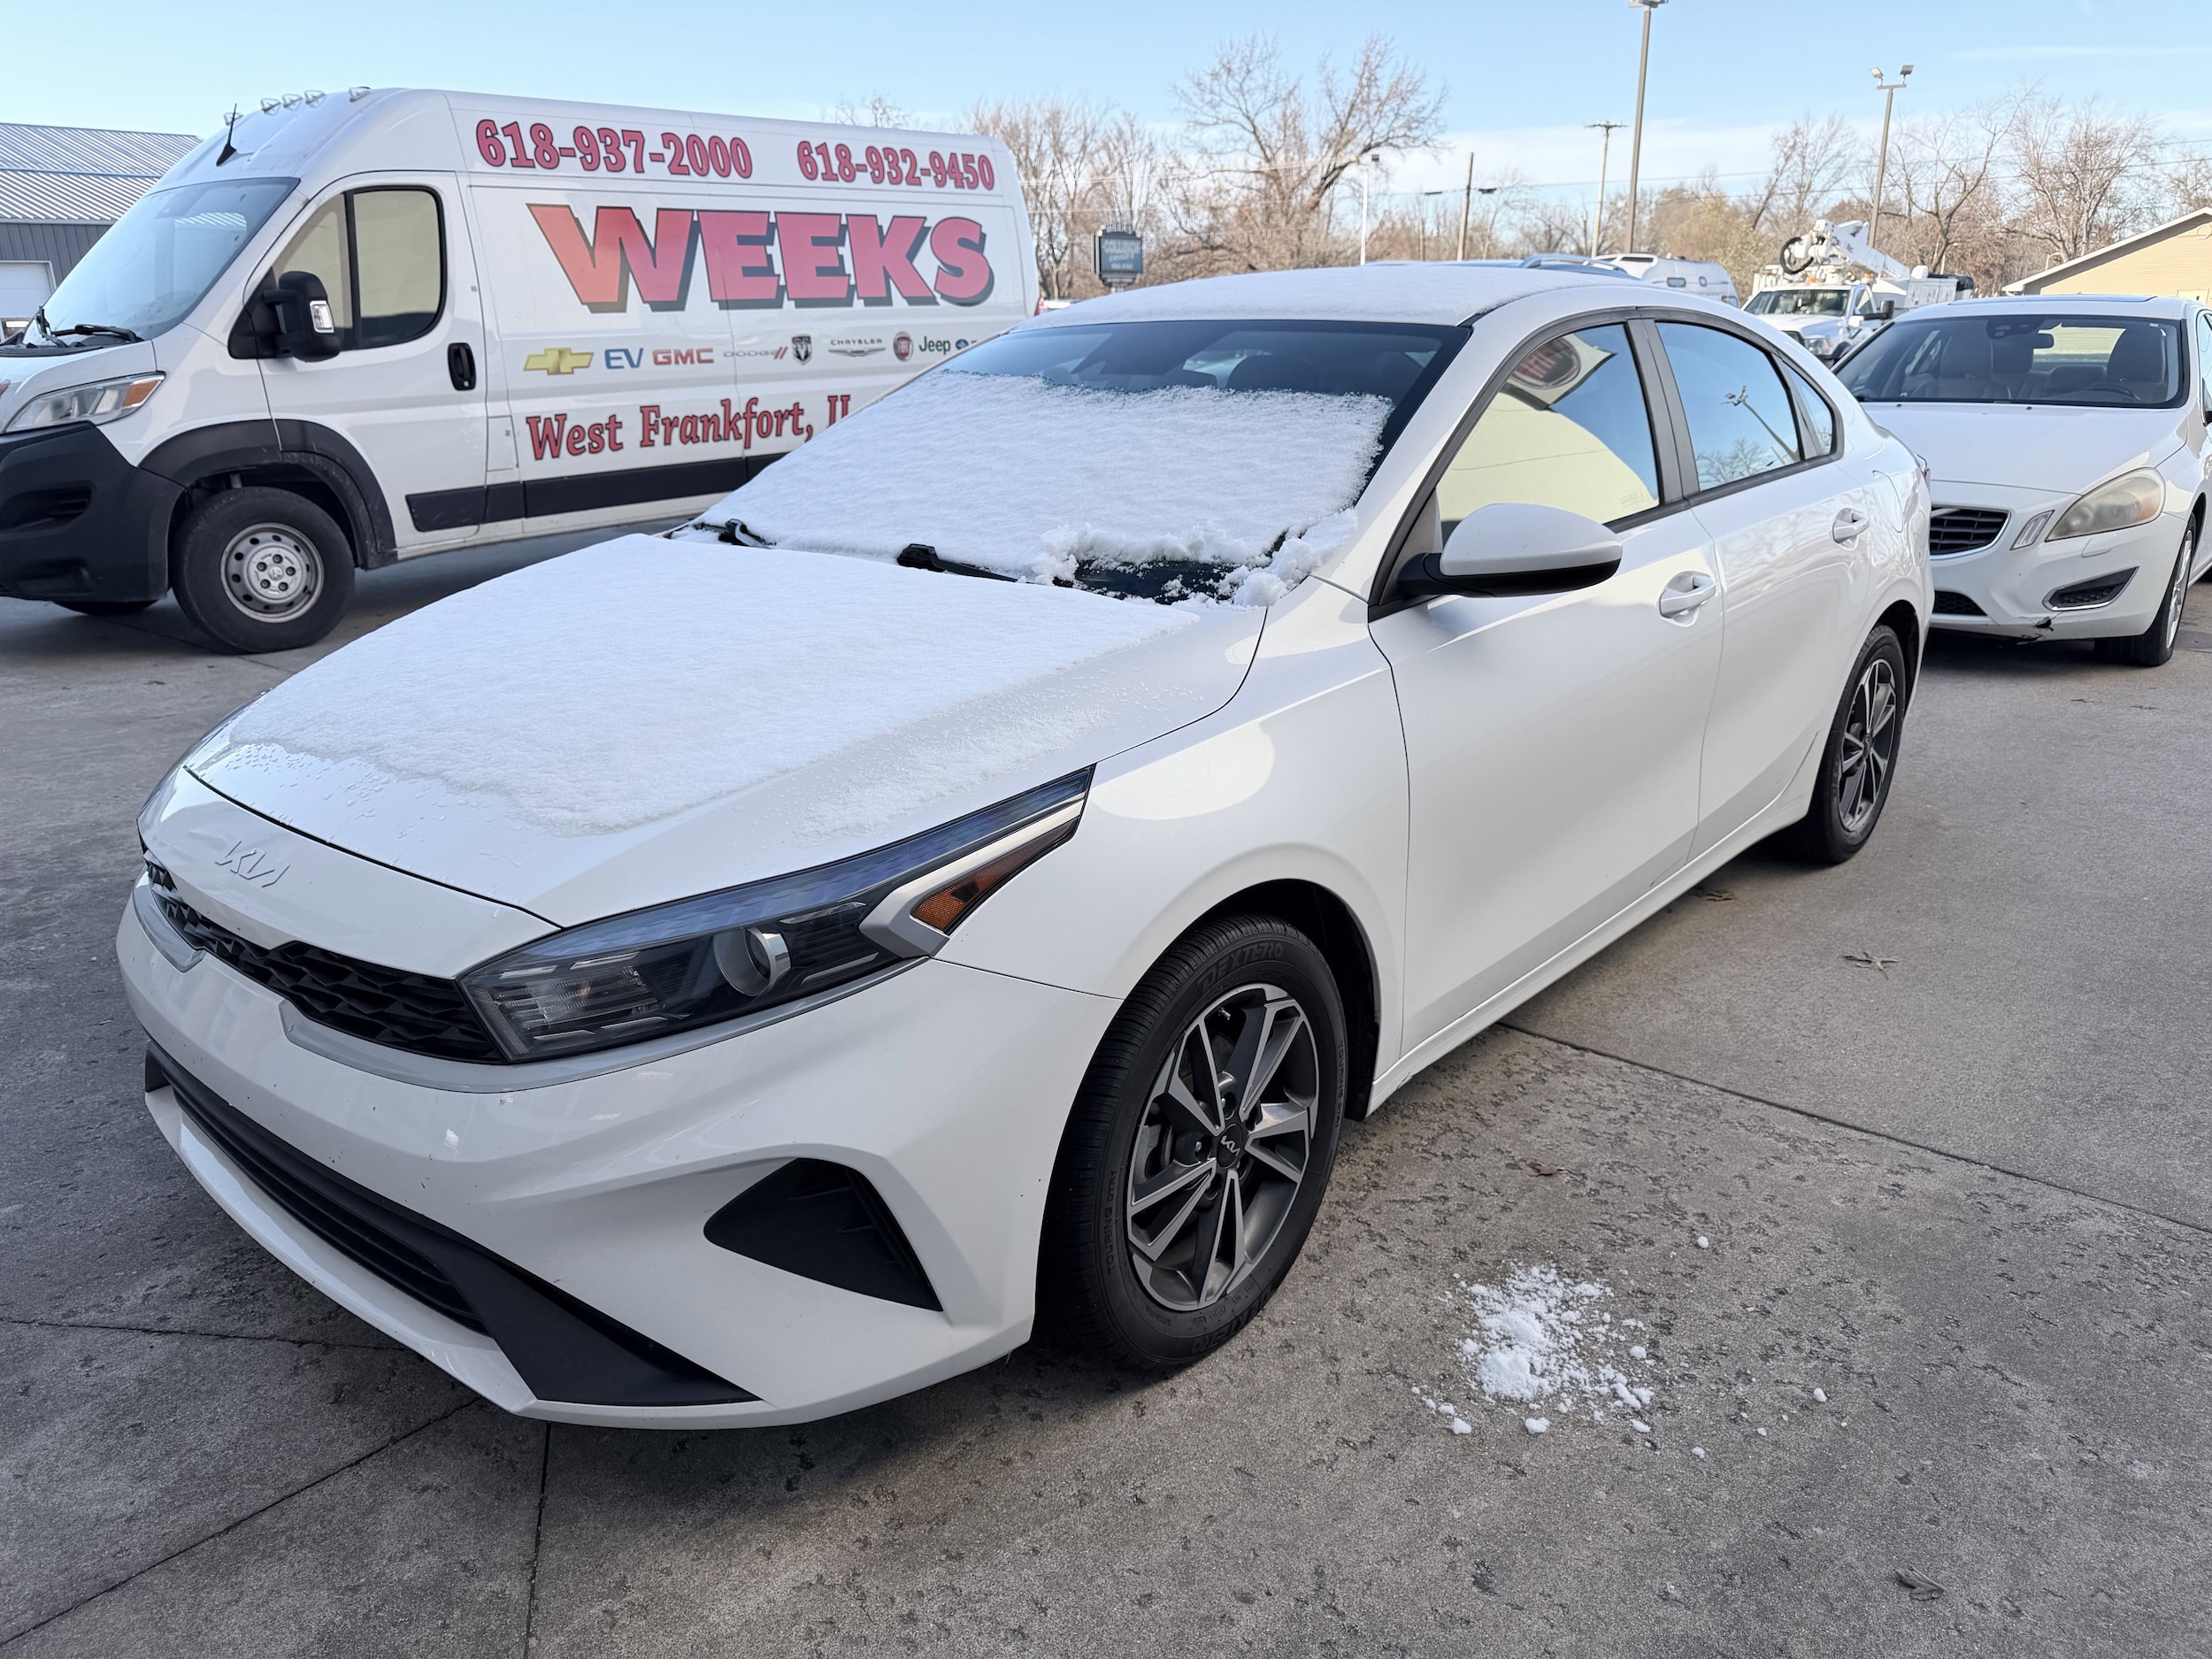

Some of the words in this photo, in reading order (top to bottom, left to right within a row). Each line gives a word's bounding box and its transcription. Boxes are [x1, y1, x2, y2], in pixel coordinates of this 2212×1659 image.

[476, 119, 753, 179] 618-937-2000
[797, 141, 995, 190] 618-932-9450
[526, 203, 995, 313] WEEKS
[603, 348, 644, 370] EV
[652, 348, 714, 365] GMC
[918, 335, 951, 355] Jeep
[526, 413, 624, 460] West
[640, 397, 814, 449] Frankfort,
[1195, 941, 1284, 992] DEXTERO
[1107, 1170, 1118, 1202] DTR1
[1104, 1206, 1116, 1275] TOURING
